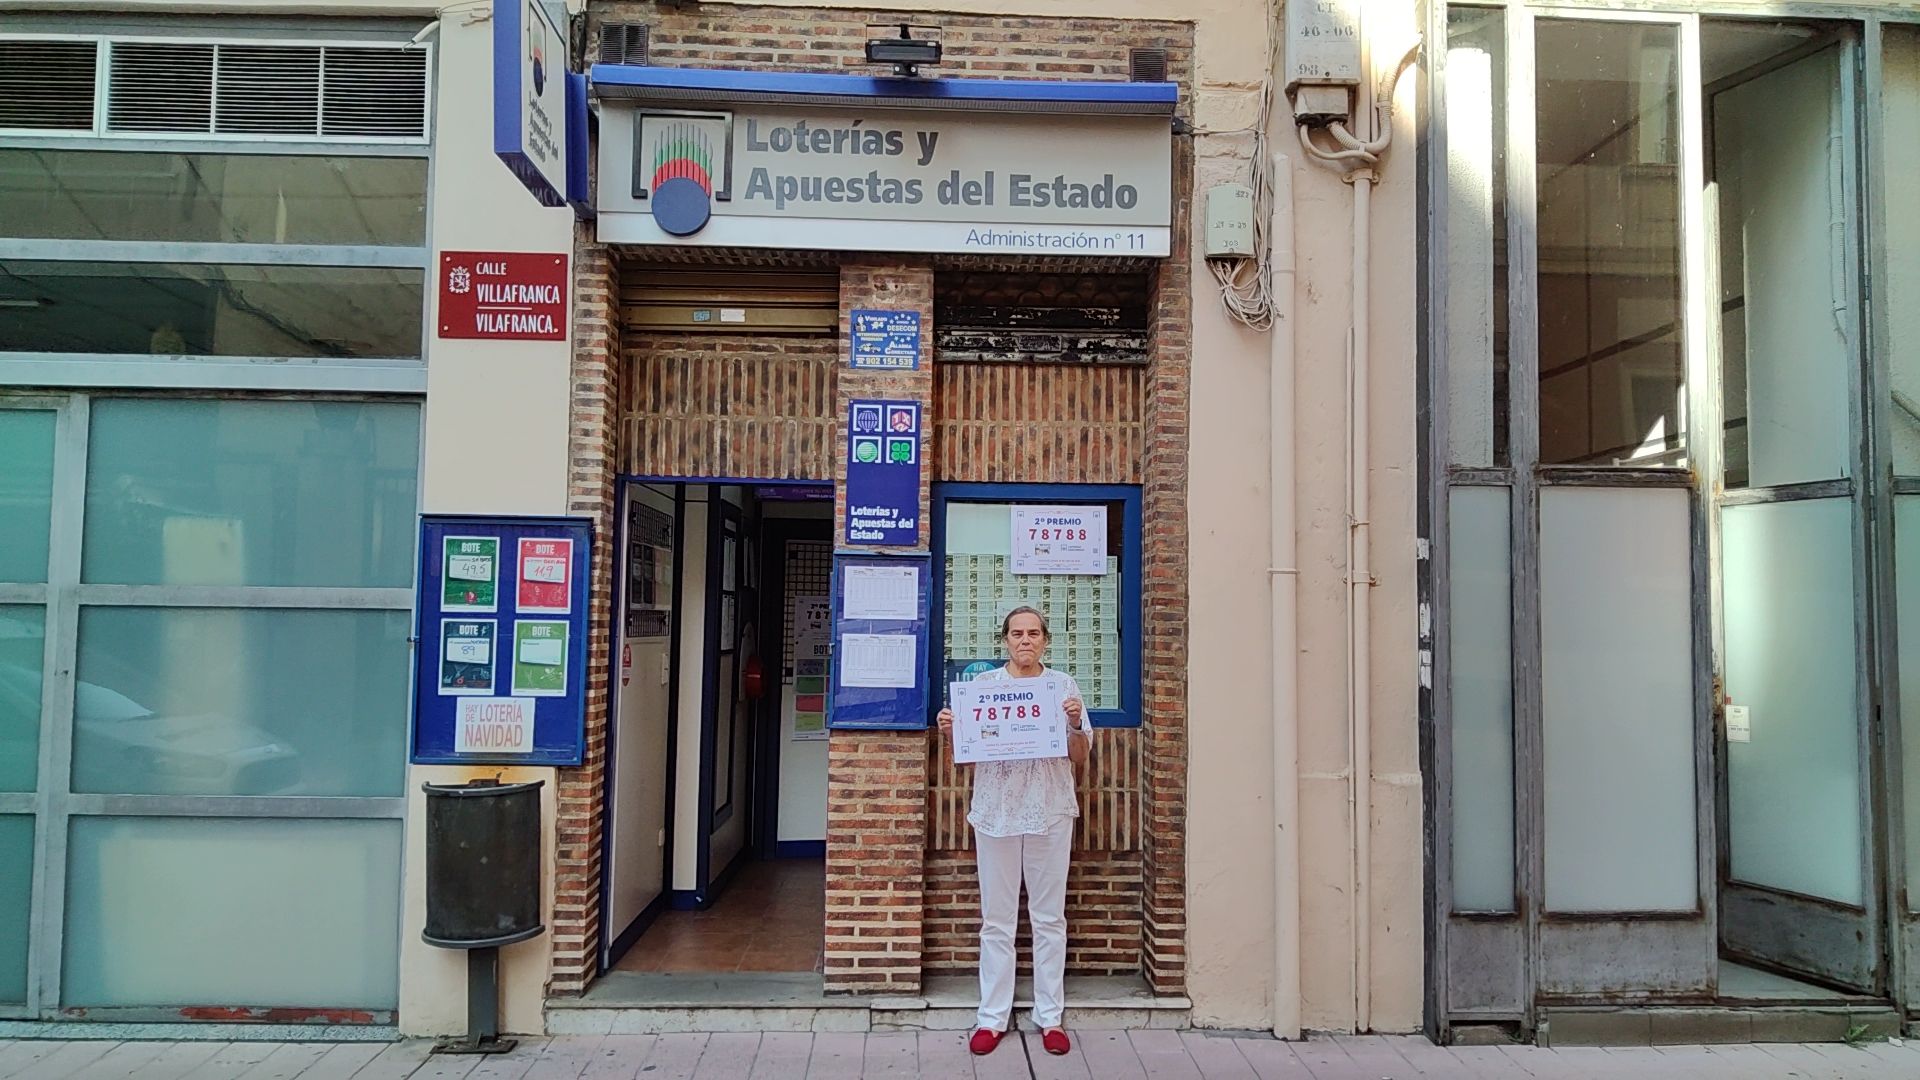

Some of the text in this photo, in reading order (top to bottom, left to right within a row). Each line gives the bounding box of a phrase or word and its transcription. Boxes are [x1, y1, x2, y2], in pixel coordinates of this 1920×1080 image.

[745, 118, 939, 166] Loterías y
[744, 167, 1138, 210] Apuestas del Estado
[965, 228, 1099, 250] Administración
[1127, 233, 1144, 250] 11
[476, 262, 507, 276] CALLE
[476, 283, 561, 304] VILLAFRANCA
[475, 313, 553, 334] VILAFRANCA
[850, 505, 899, 519] Loterías y
[850, 517, 914, 530] Apuestas del
[1047, 517, 1082, 526] PREMIO
[850, 530, 885, 540] Estado
[461, 542, 481, 553] BOTE
[535, 544, 556, 555] BOTE
[459, 624, 479, 635] BOTE
[531, 625, 552, 637] BOTE
[813, 644, 829, 655] BOT
[973, 663, 986, 672] HAY
[992, 691, 1034, 703] PREMIO
[465, 704, 479, 713] HAY
[465, 700, 523, 723] DE LOTERÍA
[464, 724, 523, 747] NAVIDAD
